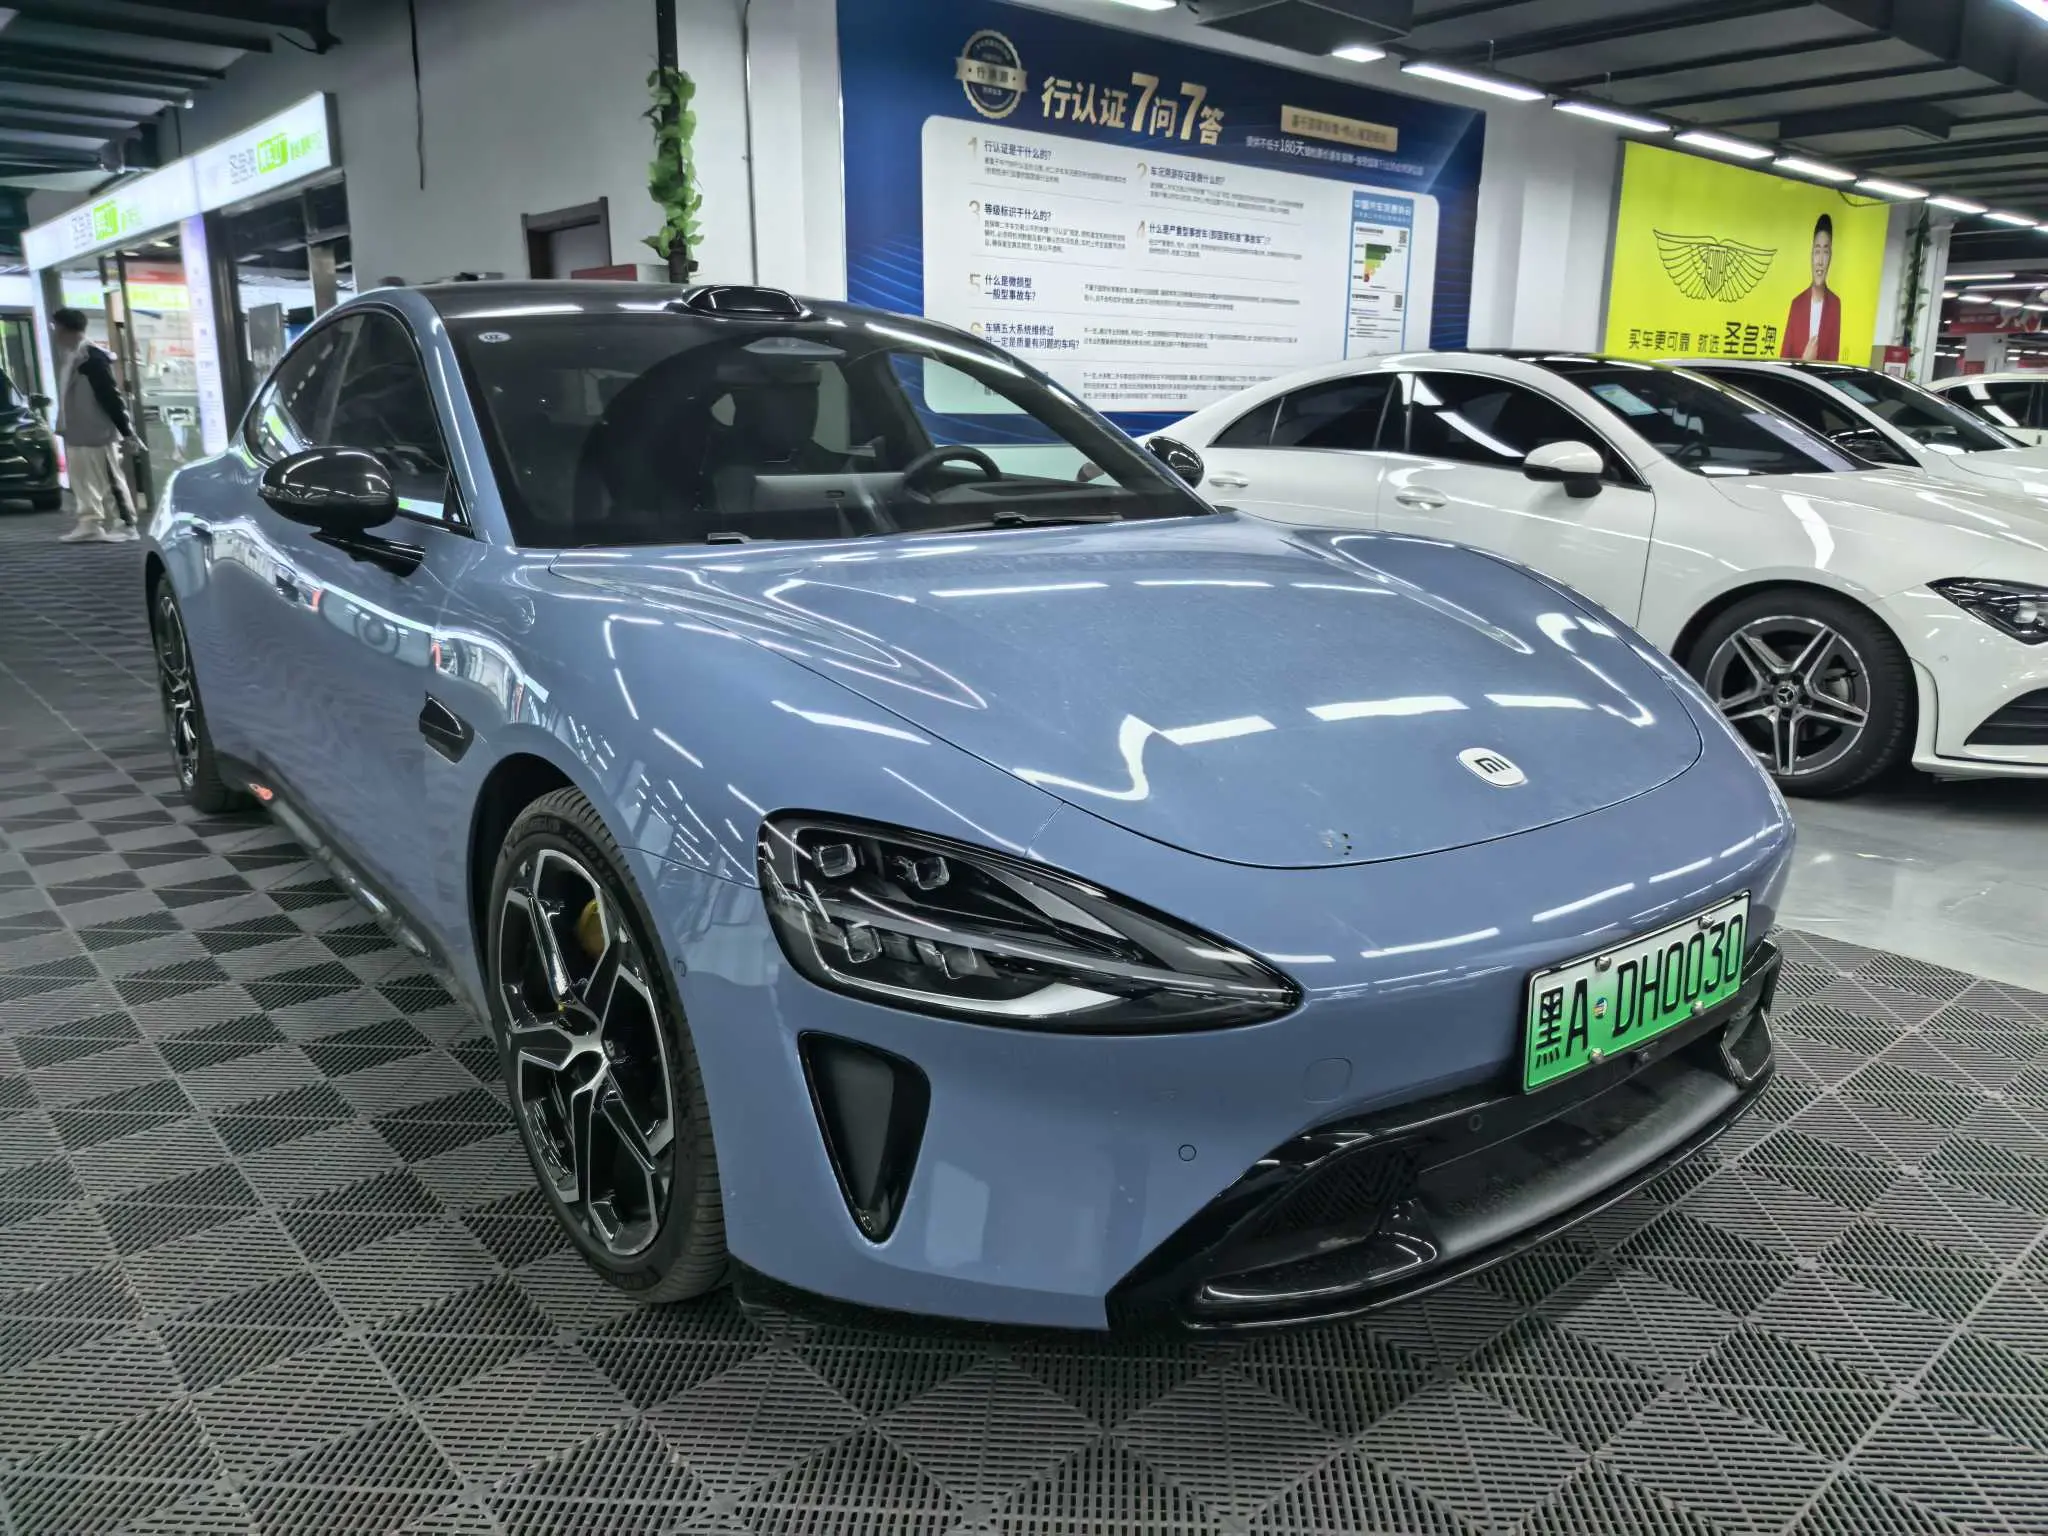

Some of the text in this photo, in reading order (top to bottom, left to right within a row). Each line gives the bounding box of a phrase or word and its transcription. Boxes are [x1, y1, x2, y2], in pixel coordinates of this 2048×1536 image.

[1041, 71, 1224, 145] 行认证7问7答
[985, 323, 1054, 335] 车辆五大系统维修过
